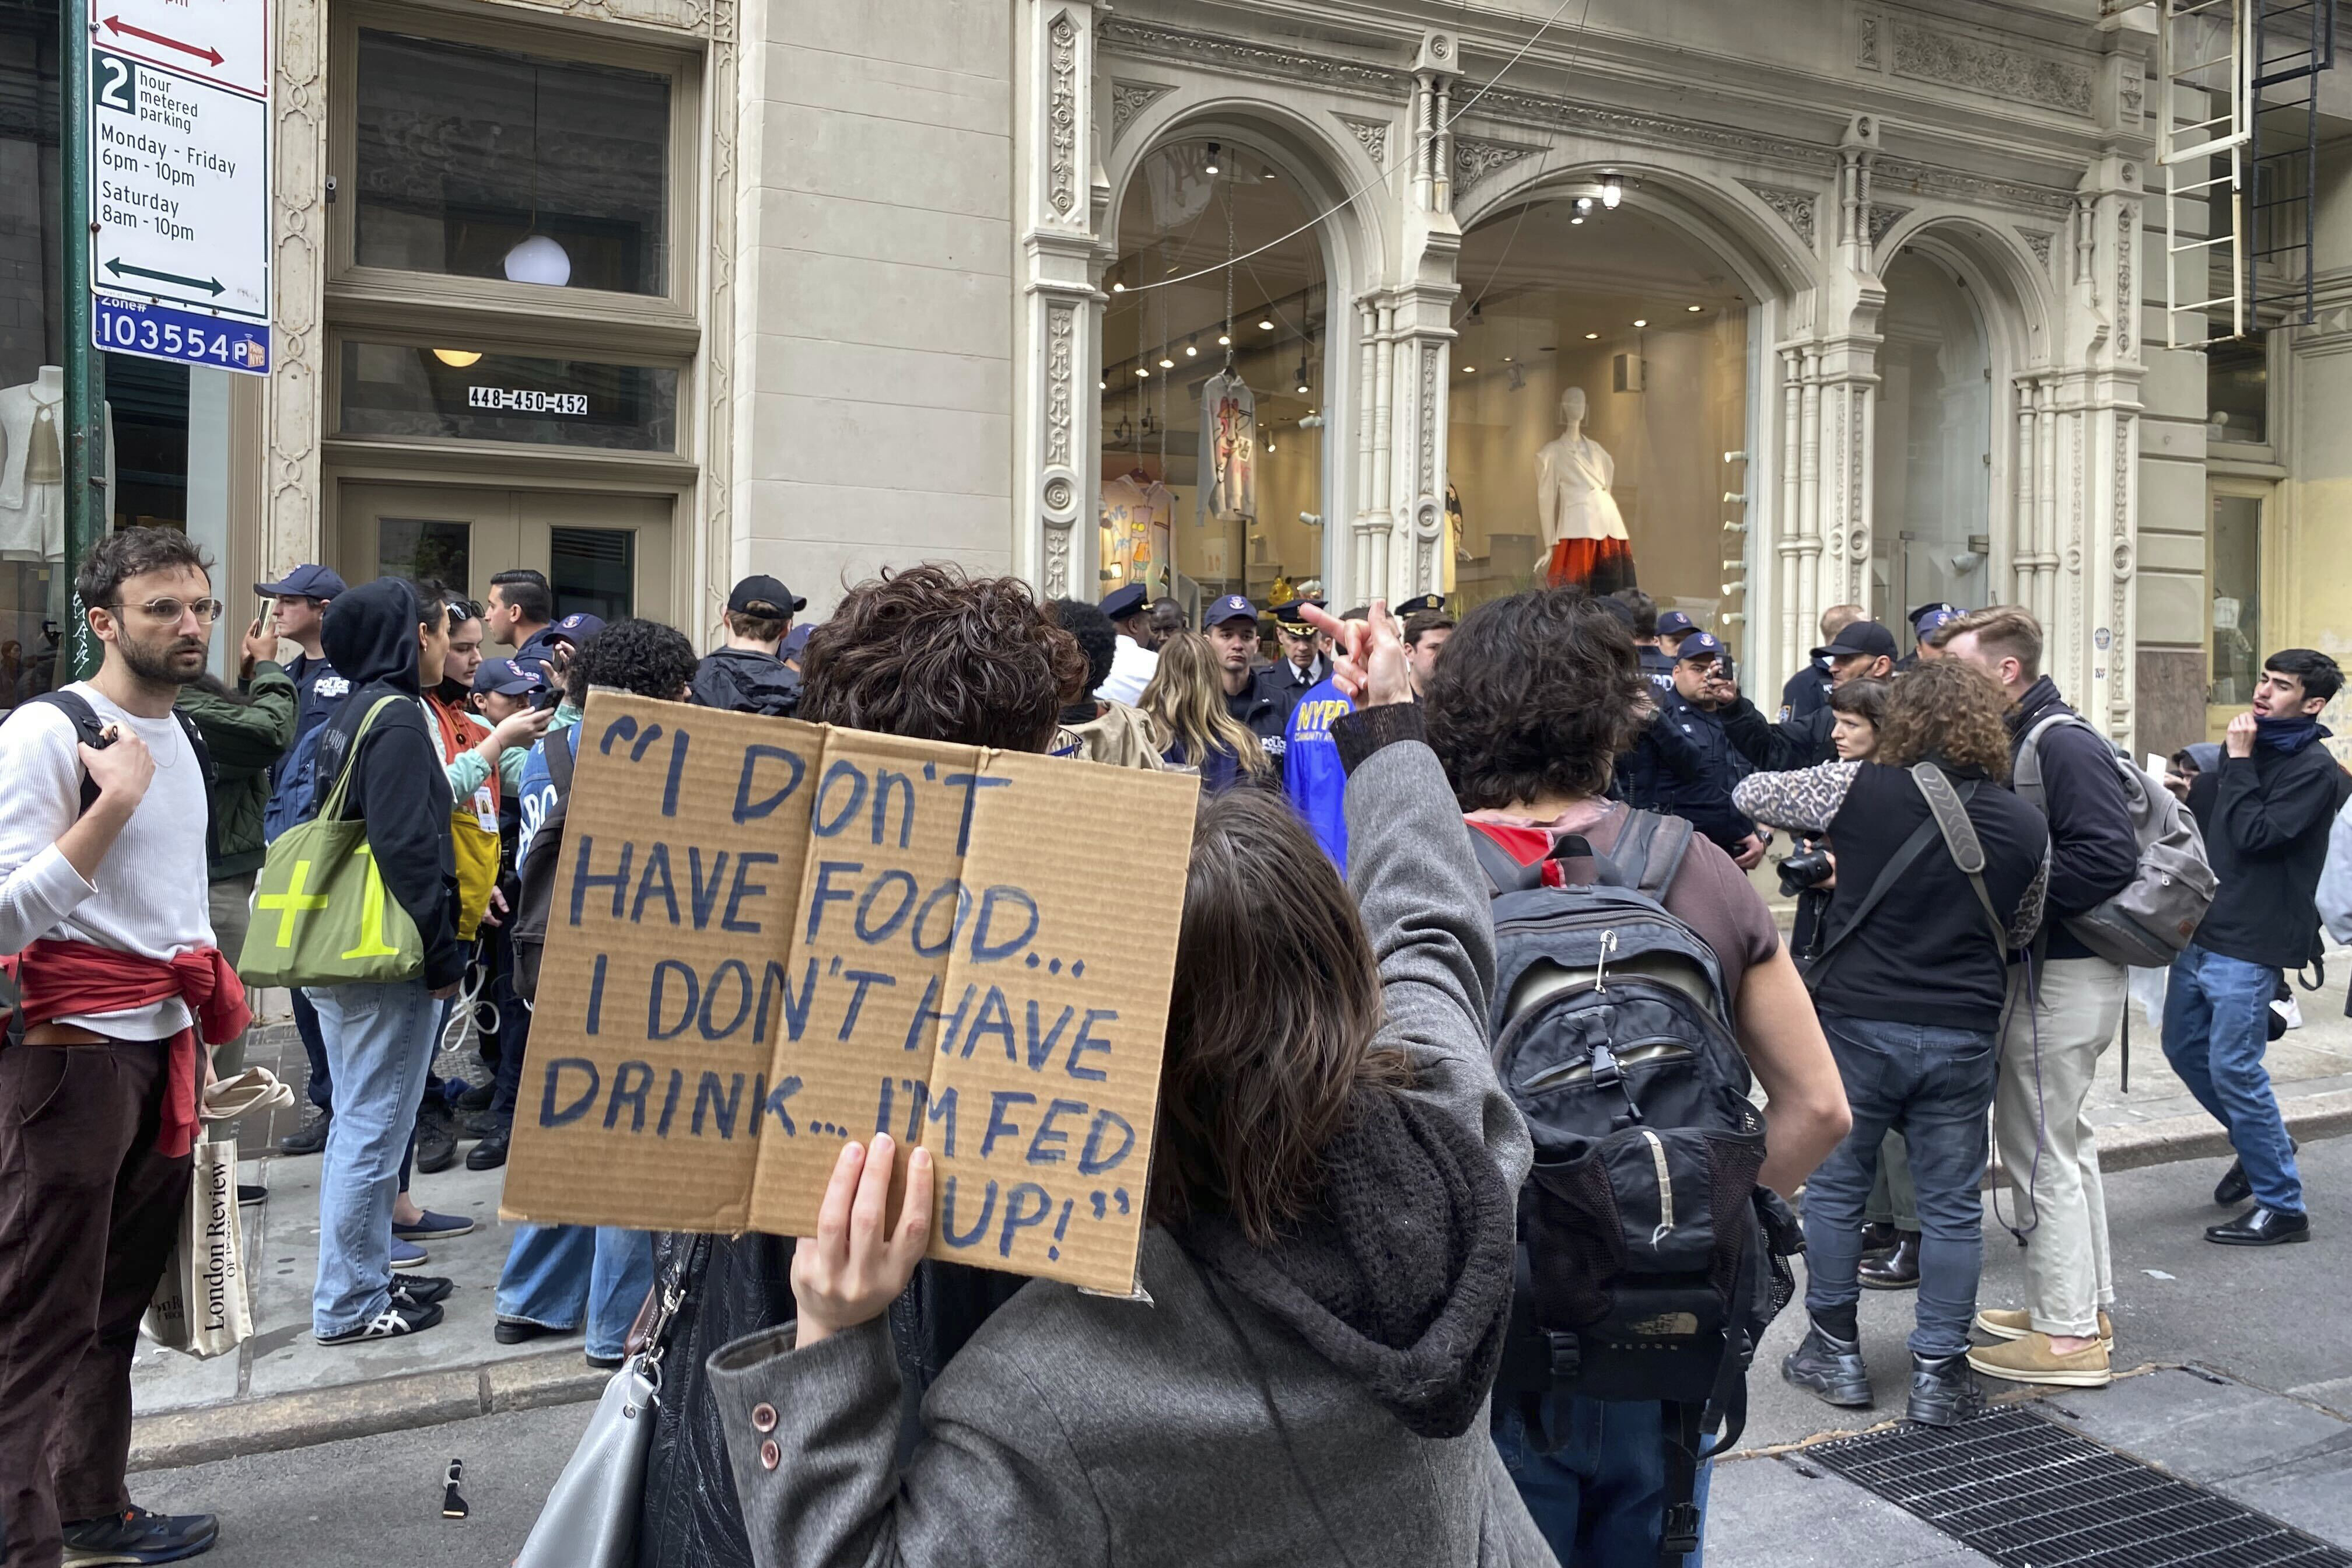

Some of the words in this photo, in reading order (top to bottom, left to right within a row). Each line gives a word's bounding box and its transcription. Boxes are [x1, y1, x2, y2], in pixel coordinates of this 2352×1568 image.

[102, 57, 128, 109] 2
[141, 71, 171, 93] hour
[141, 91, 198, 117] metered
[141, 107, 191, 134] parking
[102, 123, 166, 160] Monday
[188, 147, 236, 178] Friday
[103, 148, 138, 172] 6pm
[155, 161, 195, 187] 10pm
[103, 180, 178, 218] Saturday
[103, 205, 136, 228] 8am
[155, 216, 194, 241] 10pm
[101, 297, 147, 313] Zone#
[102, 313, 229, 362] 103554
[250, 352, 264, 366] NYC
[1297, 700, 1349, 730] NYPD
[1261, 737, 1287, 749] POLICE
[570, 835, 779, 933] HAVE
[805, 860, 1086, 979] FOOD...
[586, 954, 607, 1035] I
[647, 954, 897, 1045] DON'T
[905, 974, 1119, 1082] HAVE
[540, 1058, 848, 1141] DRINK...
[981, 1091, 1136, 1175] FED
[206, 1161, 226, 1239] Review
[203, 1242, 225, 1332] London
[226, 1260, 235, 1278] OF
